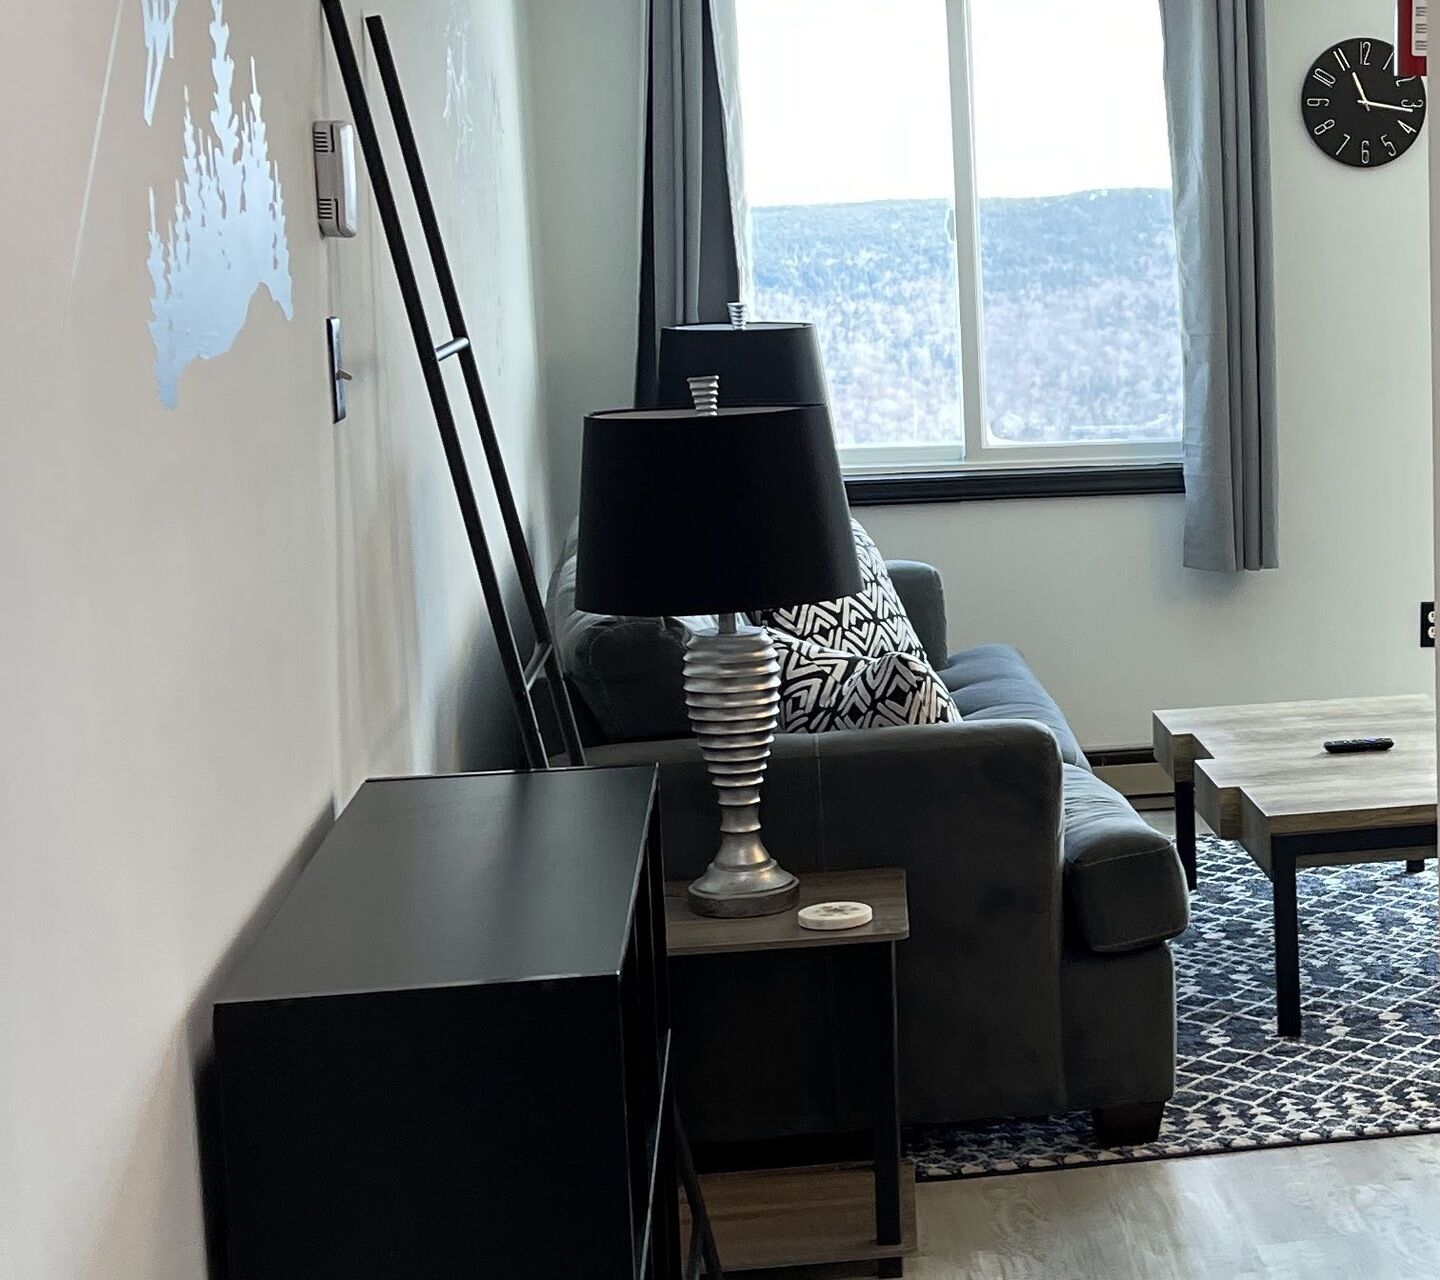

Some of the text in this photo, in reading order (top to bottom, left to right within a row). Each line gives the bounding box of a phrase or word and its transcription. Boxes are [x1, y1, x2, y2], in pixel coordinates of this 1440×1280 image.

[1332, 47, 1351, 71] 11
[1359, 41, 1371, 66] 12
[1312, 68, 1336, 88] 10
[1306, 97, 1330, 107] 9
[1400, 98, 1424, 108] 3
[1313, 119, 1336, 135] 8
[1396, 119, 1418, 135] 4
[1335, 133, 1351, 156] 7
[1361, 140, 1370, 164] 6
[1380, 133, 1397, 157] 5
